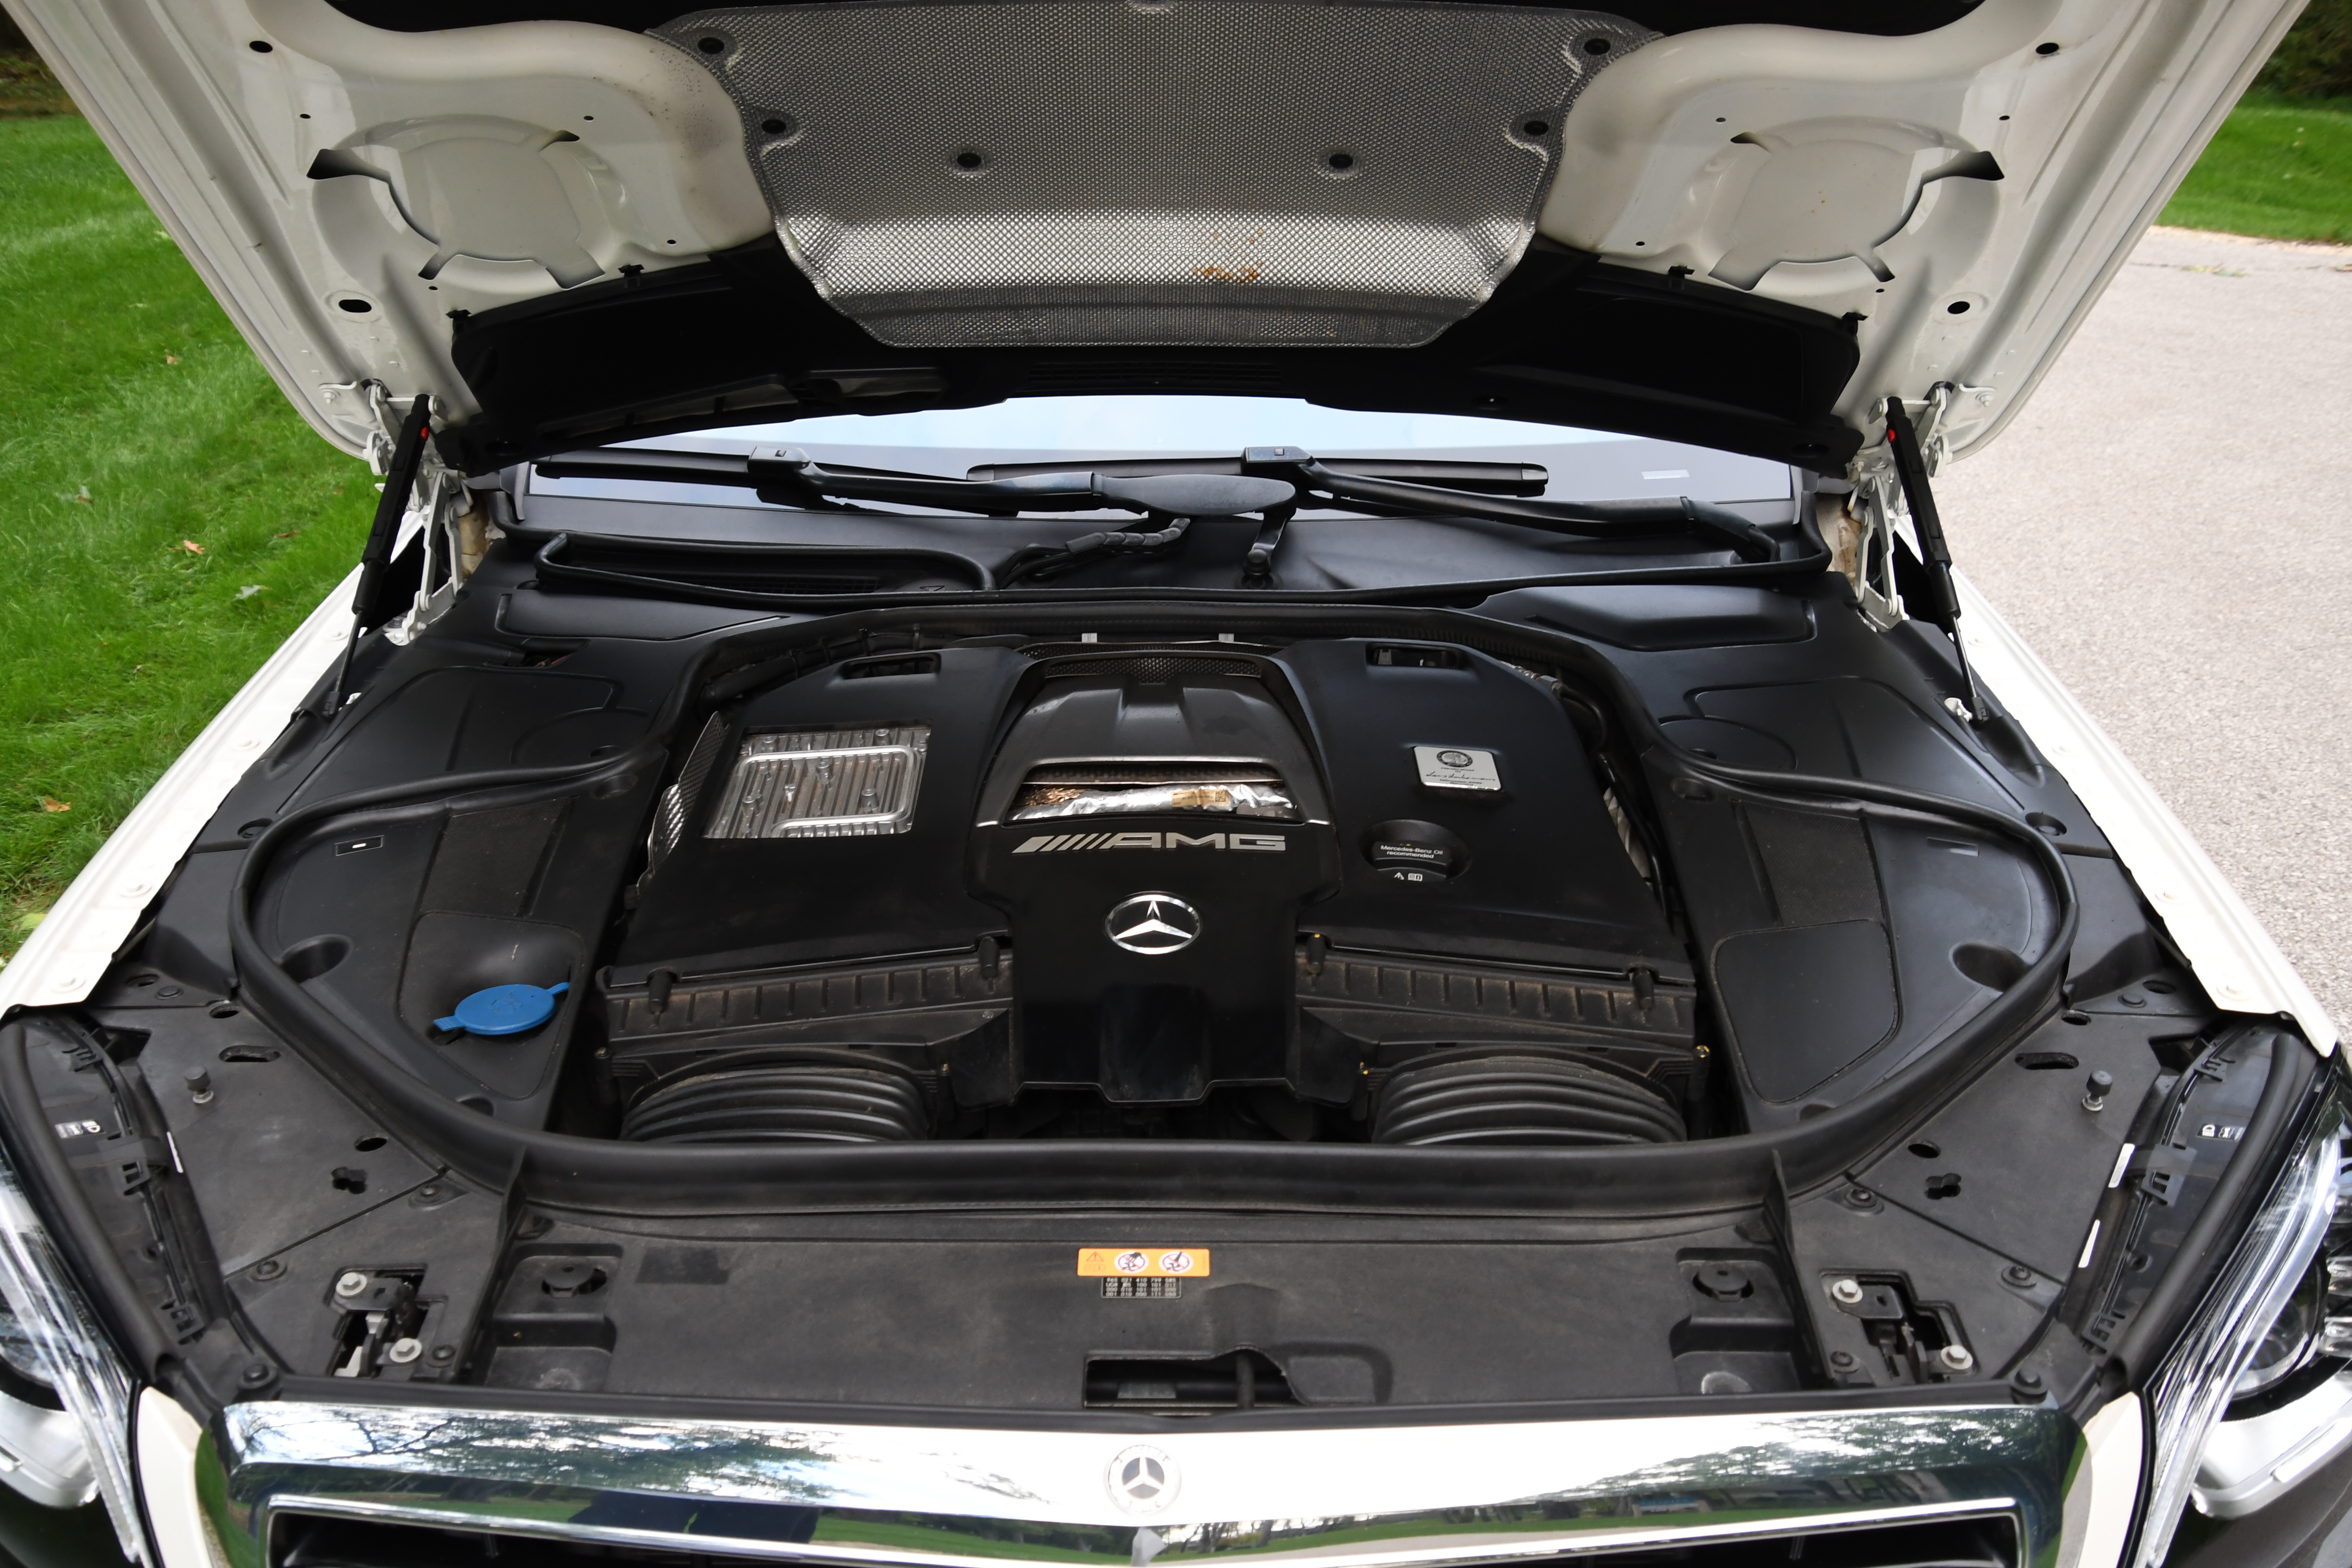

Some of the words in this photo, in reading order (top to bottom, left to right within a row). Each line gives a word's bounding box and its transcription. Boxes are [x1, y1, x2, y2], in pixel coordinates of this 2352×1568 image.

[1104, 832, 1286, 850] AMG
[1380, 845, 1432, 854] Mercedes-Benz
[1386, 850, 1435, 859] recommended
